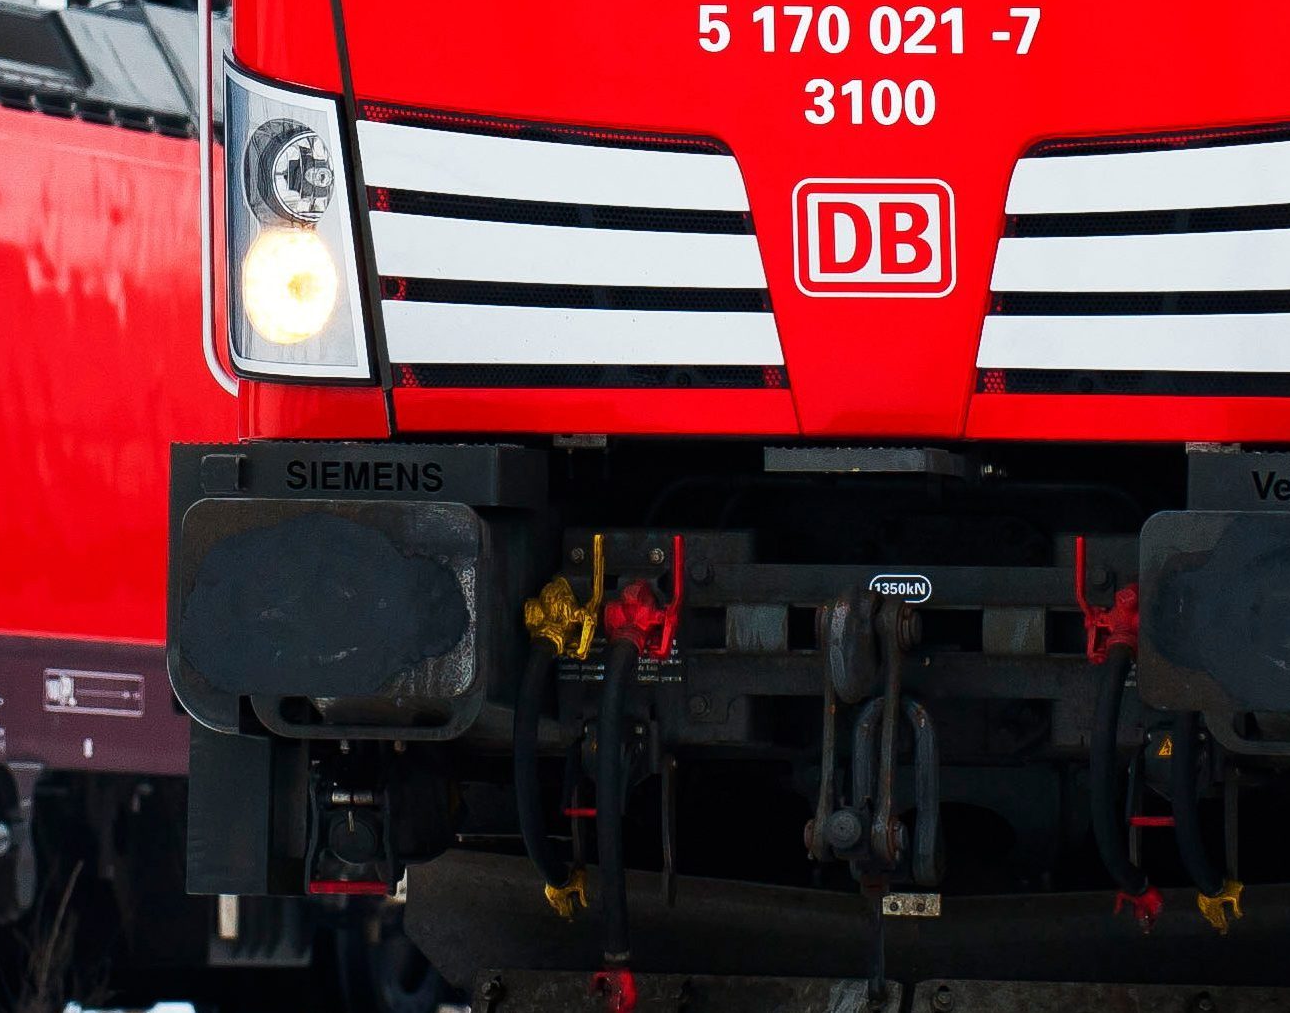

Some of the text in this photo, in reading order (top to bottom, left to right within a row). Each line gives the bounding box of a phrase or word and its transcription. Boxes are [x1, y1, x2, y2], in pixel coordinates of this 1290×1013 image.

[698, 4, 1041, 55] 5 170 021 -7
[804, 78, 936, 126] 3100
[817, 201, 934, 276] DB
[286, 460, 444, 492] SIEMENS
[874, 582, 926, 595] 1350kN
